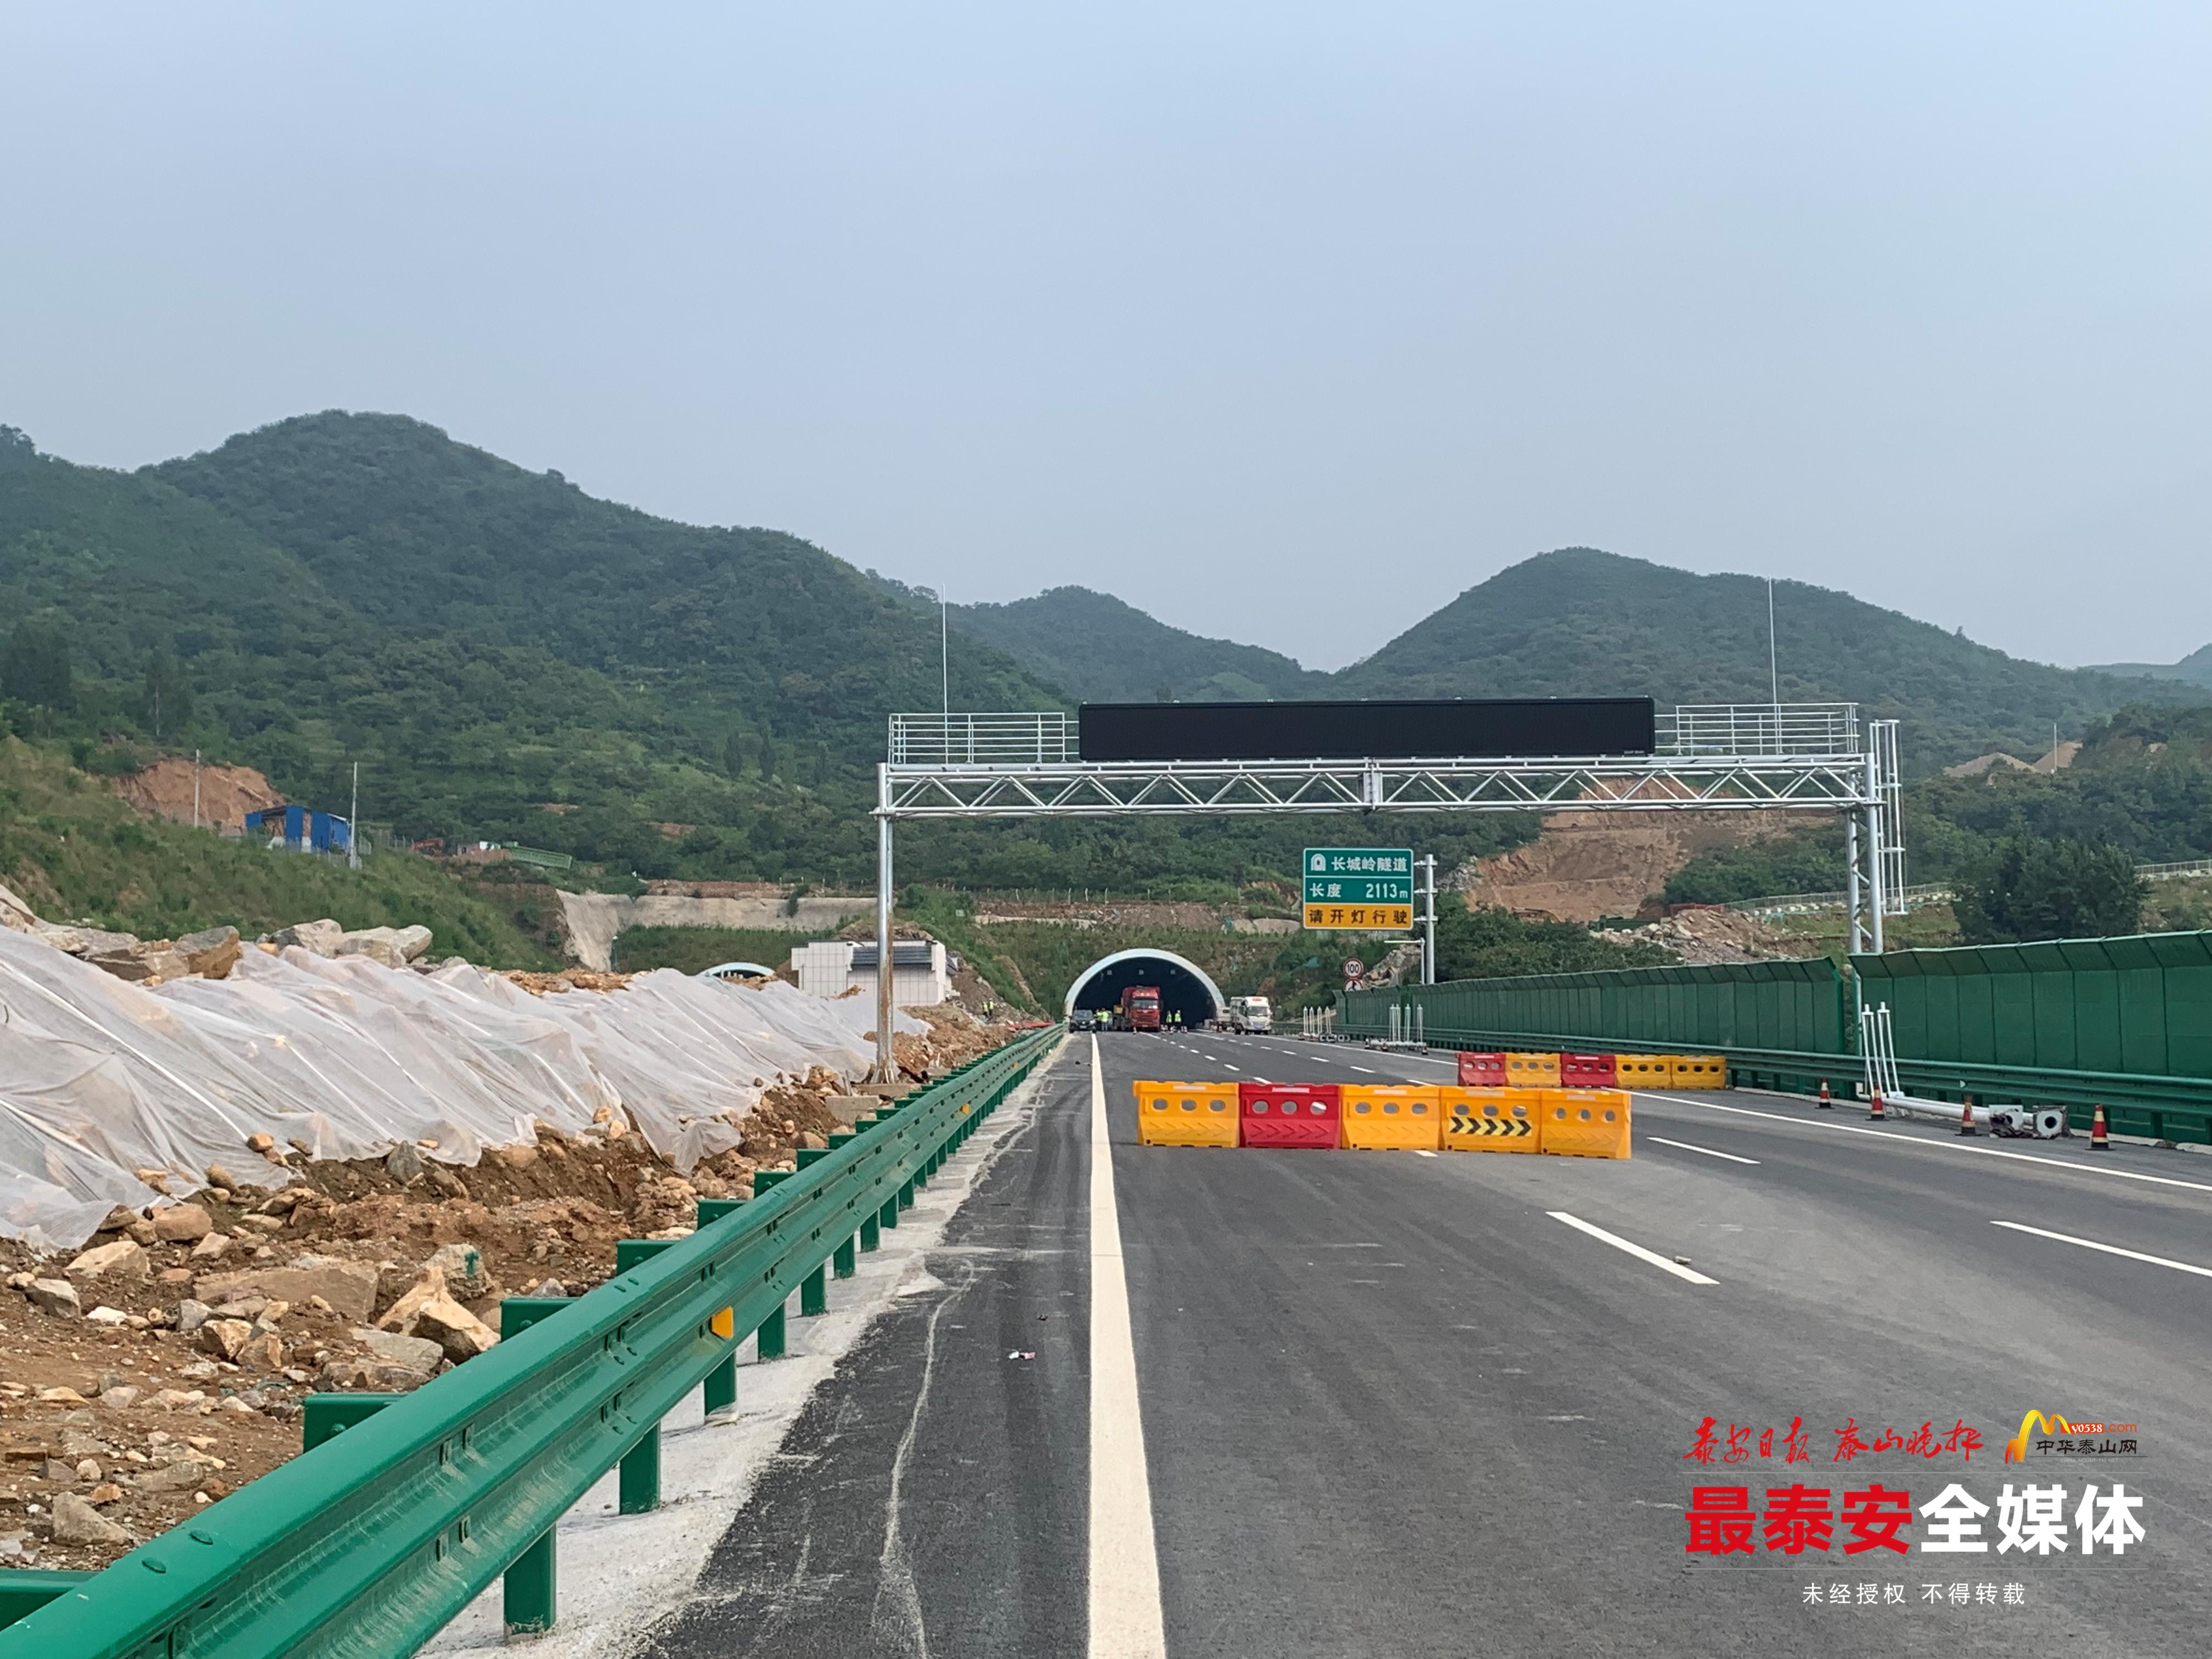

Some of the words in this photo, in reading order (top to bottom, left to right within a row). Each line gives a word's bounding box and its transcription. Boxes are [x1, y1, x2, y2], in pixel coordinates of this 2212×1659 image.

[1331, 856, 1408, 872] 长城岭隧道
[1310, 883, 1341, 898] 长度
[1309, 909, 1408, 924] 请开灯行驶
[1347, 963, 1359, 973] 100
